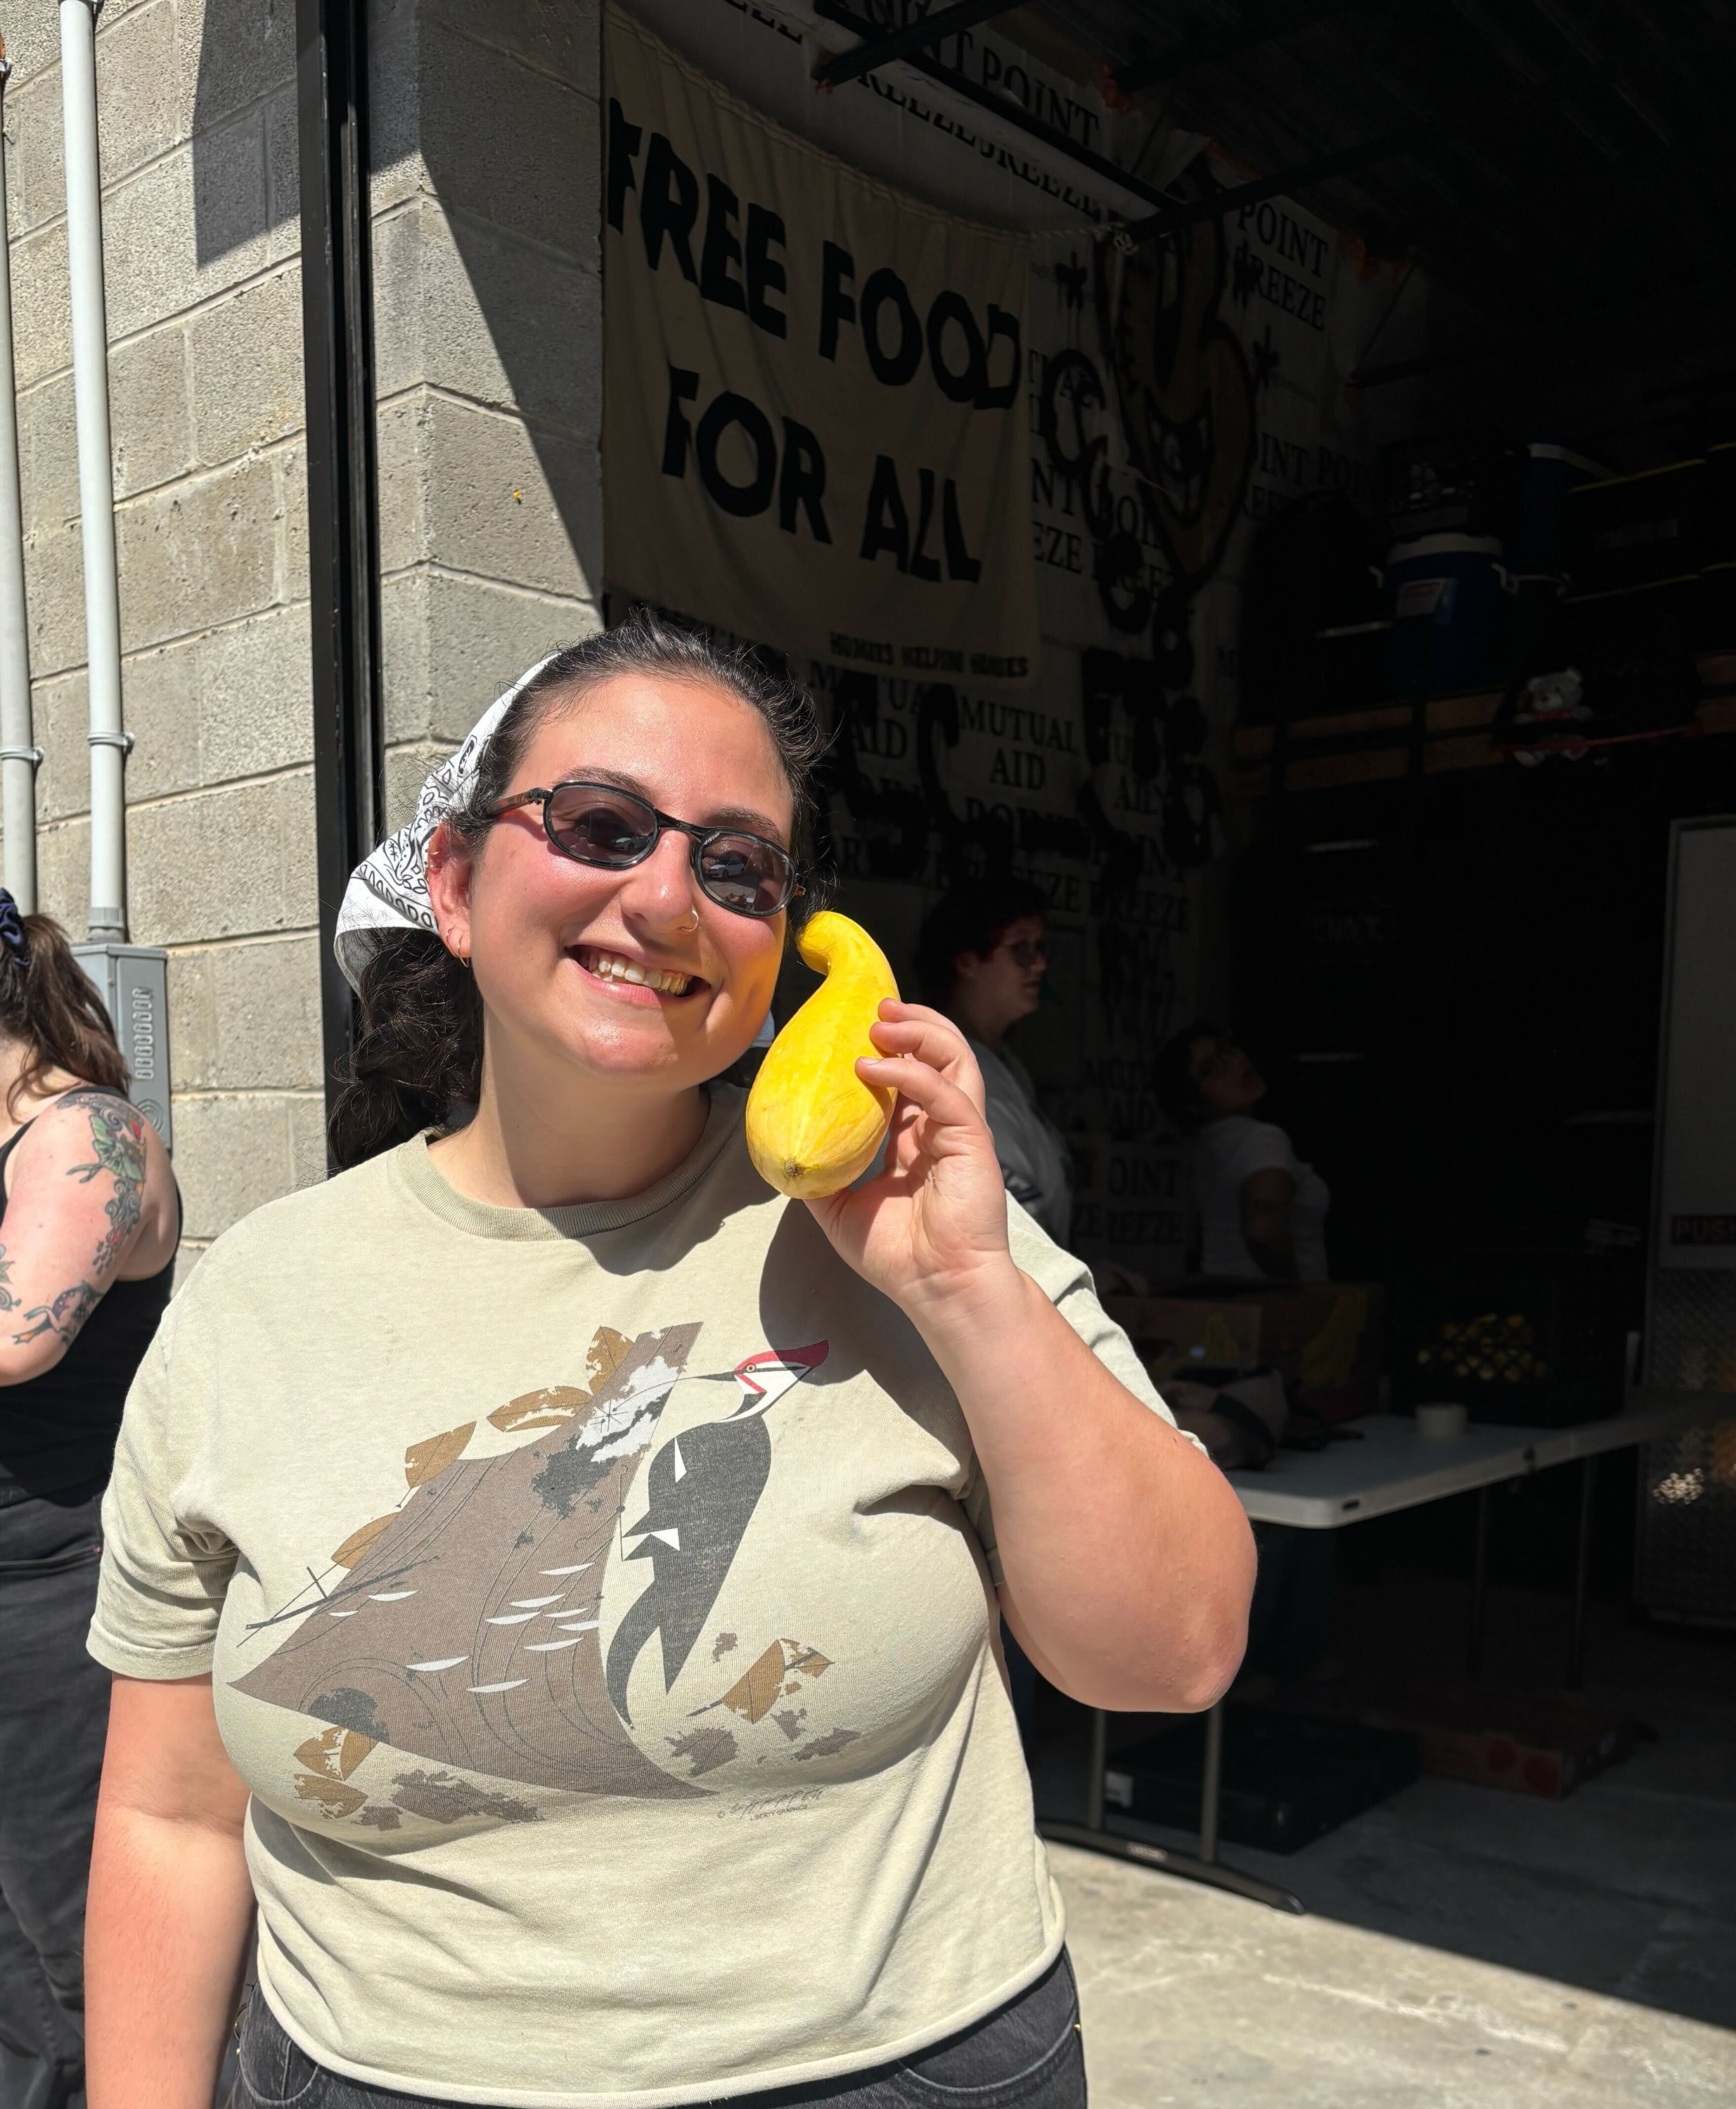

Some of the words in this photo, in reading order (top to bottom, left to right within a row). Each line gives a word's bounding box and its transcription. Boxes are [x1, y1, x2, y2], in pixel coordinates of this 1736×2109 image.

[608, 98, 786, 339] FREE
[820, 240, 1020, 410] FOOD
[662, 365, 832, 544] FOR
[859, 454, 981, 583] ALL
[959, 696, 1079, 754] MUTUAL
[990, 748, 1047, 790] AID
[1108, 1156, 1180, 1197] OINT
